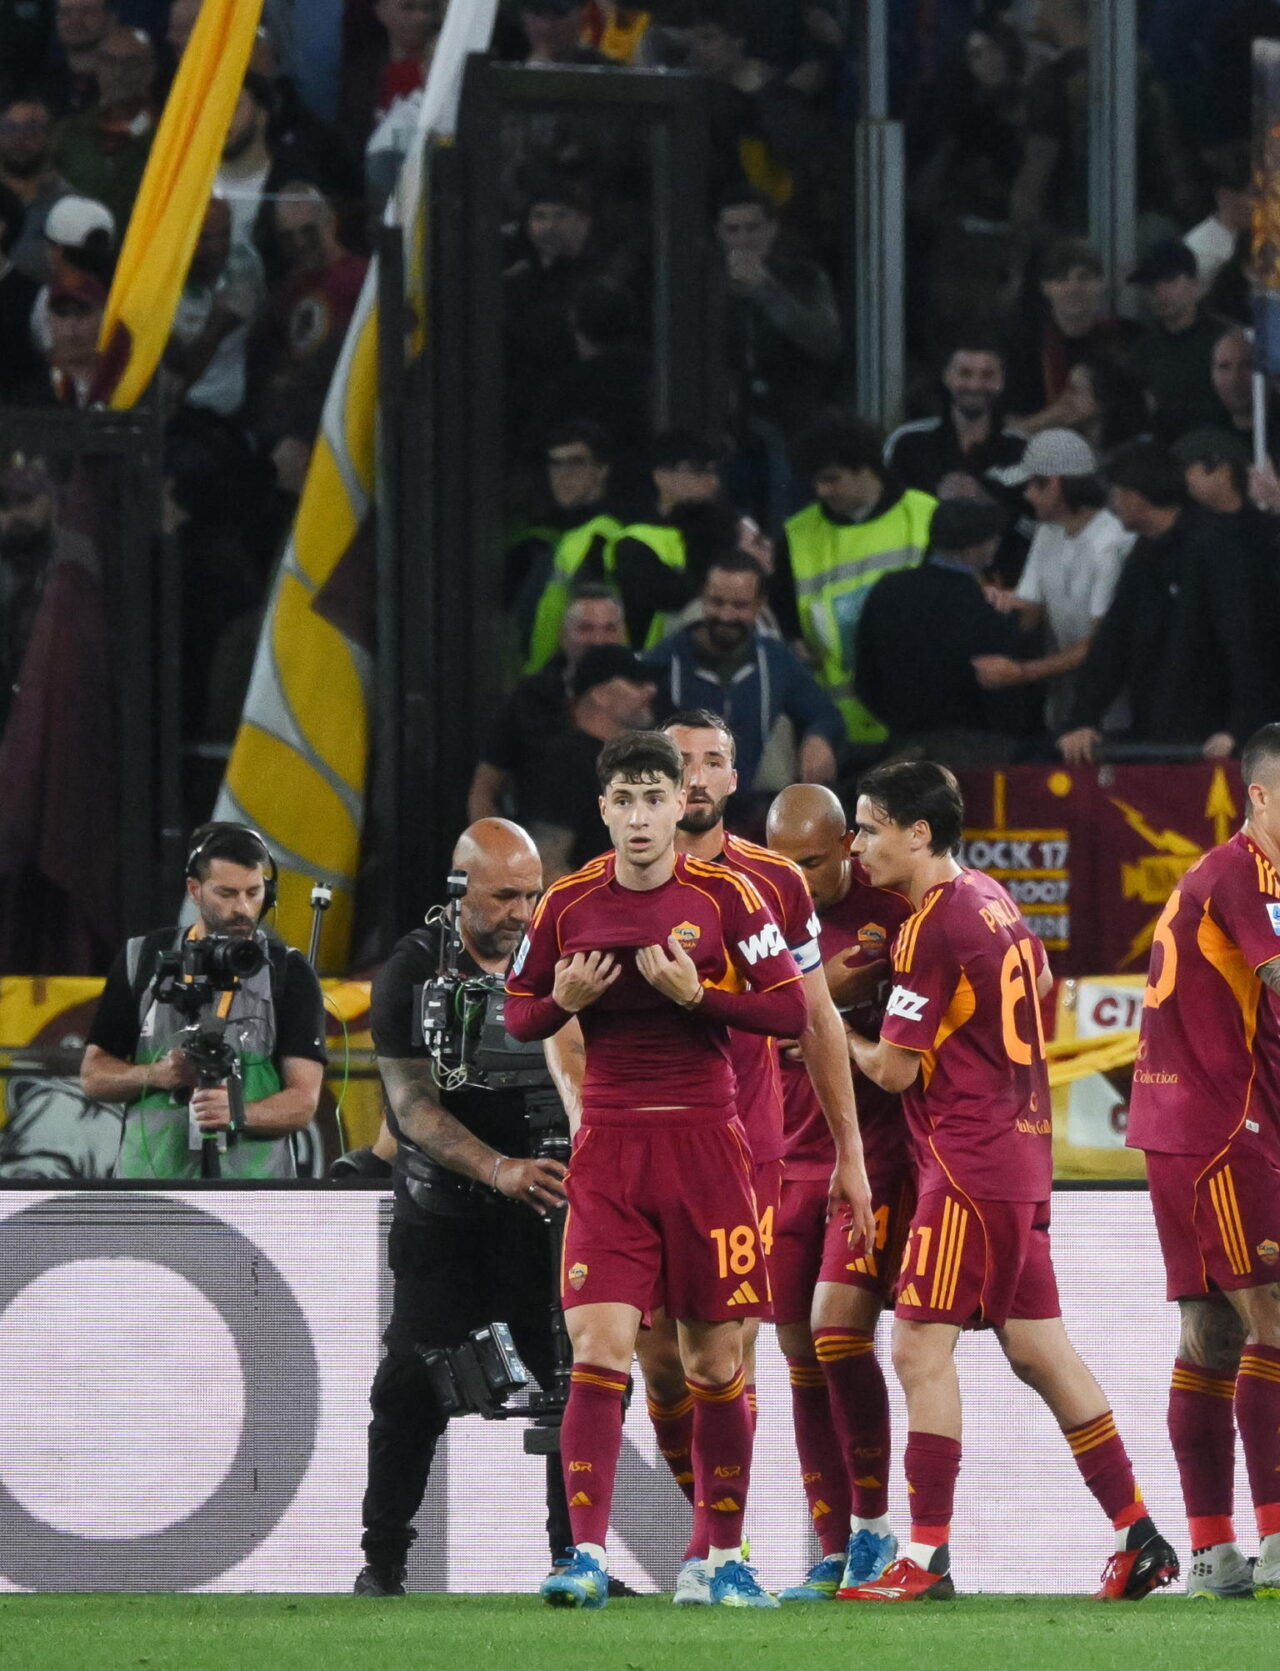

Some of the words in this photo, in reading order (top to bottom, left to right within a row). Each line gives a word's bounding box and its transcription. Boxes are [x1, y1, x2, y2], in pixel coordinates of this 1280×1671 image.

[955, 841, 1034, 869] LOCK
[1039, 841, 1069, 869] 17
[1001, 937, 1047, 1066] 61
[710, 1224, 757, 1279] 18
[567, 1461, 593, 1473] ASR
[713, 1465, 741, 1478] ASR
[802, 1472, 822, 1484] SR
